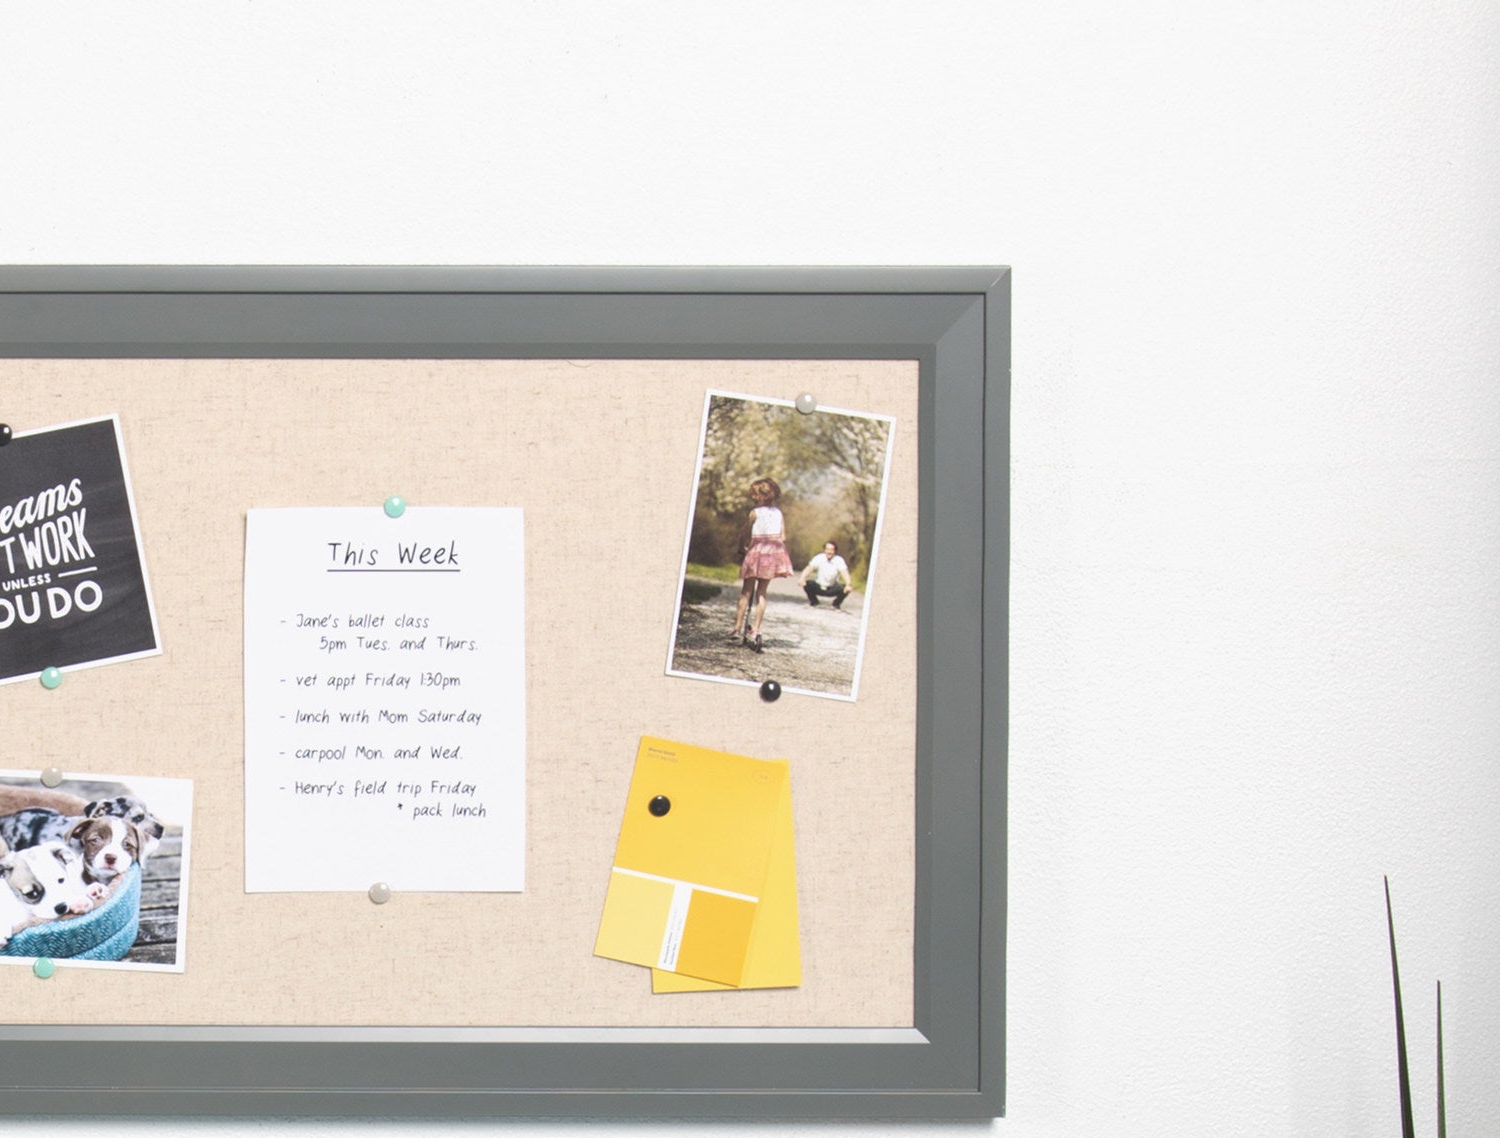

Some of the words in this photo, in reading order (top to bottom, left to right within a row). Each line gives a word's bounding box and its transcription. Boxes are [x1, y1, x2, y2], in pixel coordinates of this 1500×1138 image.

[19, 507, 95, 571] WORK
[328, 541, 379, 566] This
[398, 540, 459, 565] Week
[2, 572, 52, 592] UNLESS
[47, 580, 103, 619] DO
[296, 613, 339, 628] Jane's
[348, 614, 385, 628] ballet
[394, 613, 430, 628] class
[319, 636, 347, 654] 5pm
[356, 636, 391, 651] Tues.
[400, 636, 425, 650] and
[437, 636, 479, 651] Thurs.
[296, 673, 317, 687] vet
[327, 674, 356, 691] appt
[365, 672, 411, 690] Friday
[295, 709, 330, 724] lunch
[339, 709, 369, 724] with
[378, 709, 409, 723] Mom
[417, 709, 482, 727] Saturday
[295, 745, 346, 763] carpool
[394, 745, 421, 759] and
[430, 745, 463, 760] Wed.
[295, 780, 344, 797] Henry's
[354, 779, 387, 795] field
[397, 780, 422, 797] trip
[431, 780, 477, 797] Friday
[412, 802, 443, 821] pack
[452, 802, 486, 818] lunch
